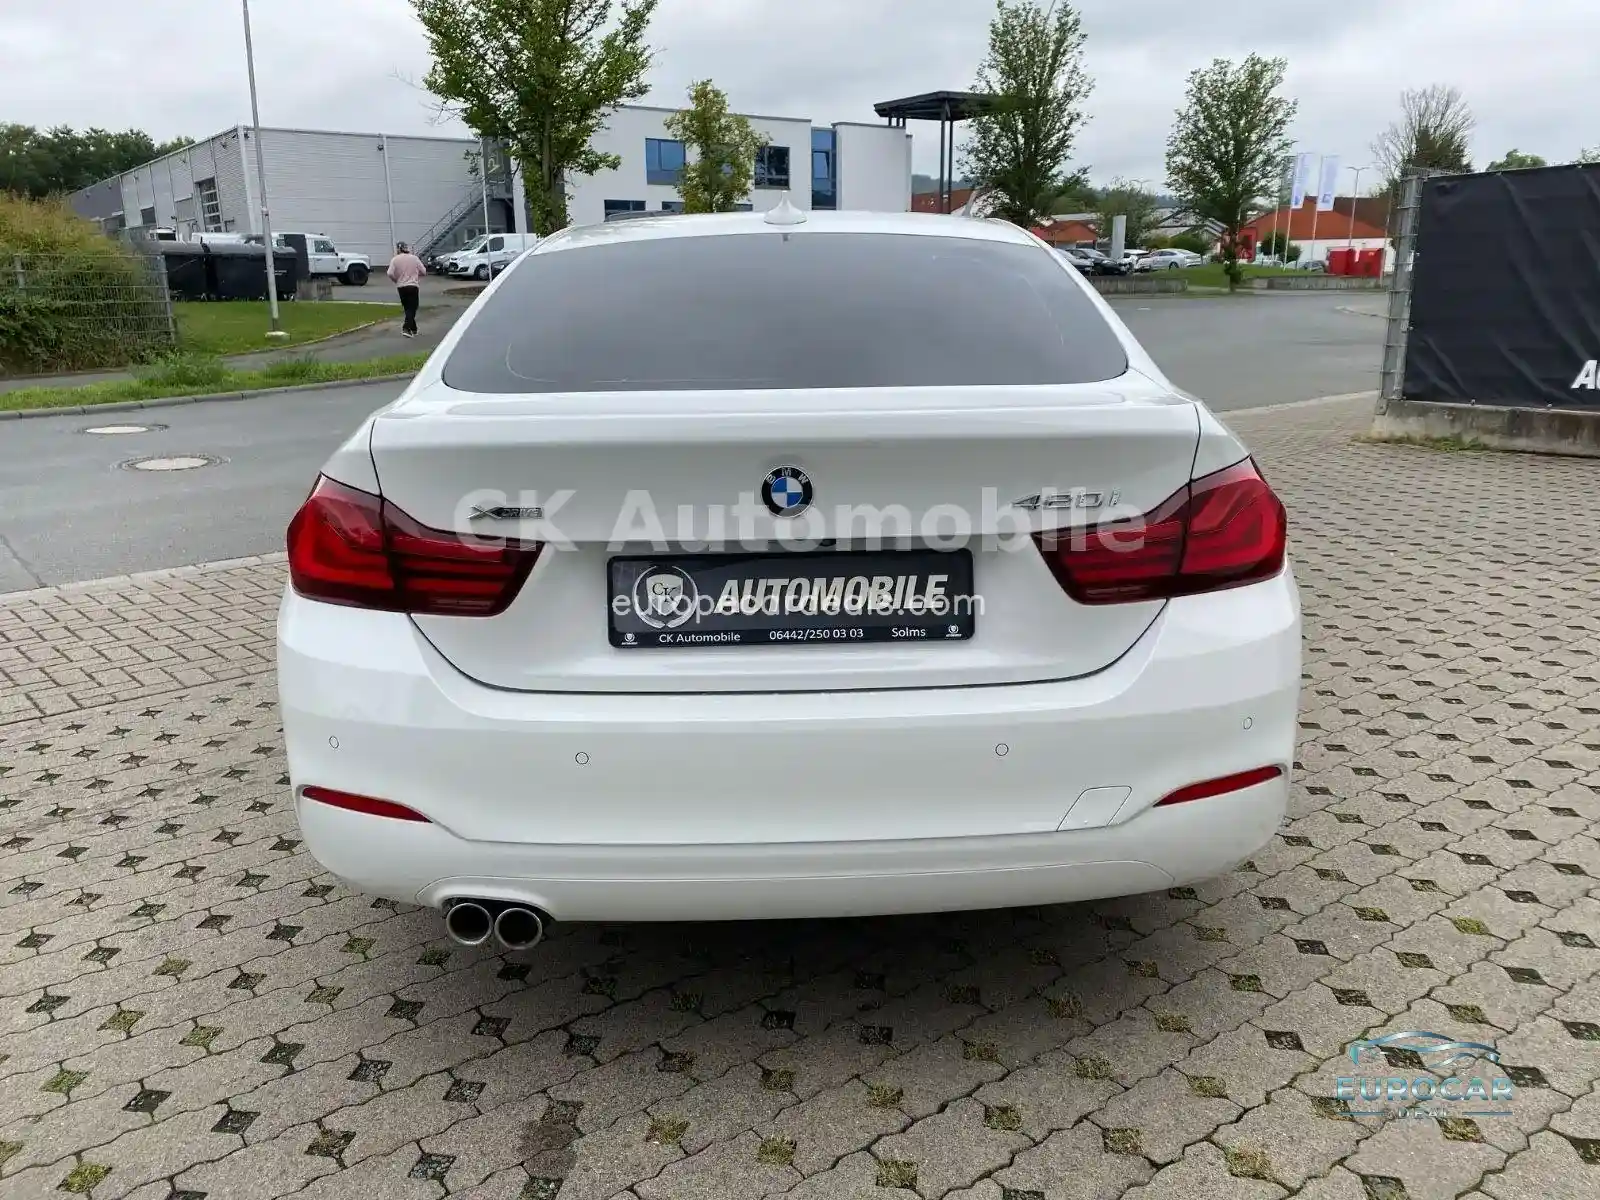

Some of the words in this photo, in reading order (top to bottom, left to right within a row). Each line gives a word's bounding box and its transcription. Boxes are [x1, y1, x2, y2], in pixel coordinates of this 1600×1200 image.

[765, 467, 809, 485] BMW
[714, 574, 948, 614] AUTOMOBILE
[659, 634, 673, 643] CK
[676, 632, 741, 643] Automobile
[769, 629, 830, 640] 06442/250
[833, 629, 847, 639] 03
[850, 628, 864, 639] 03
[891, 627, 927, 638] Solms
